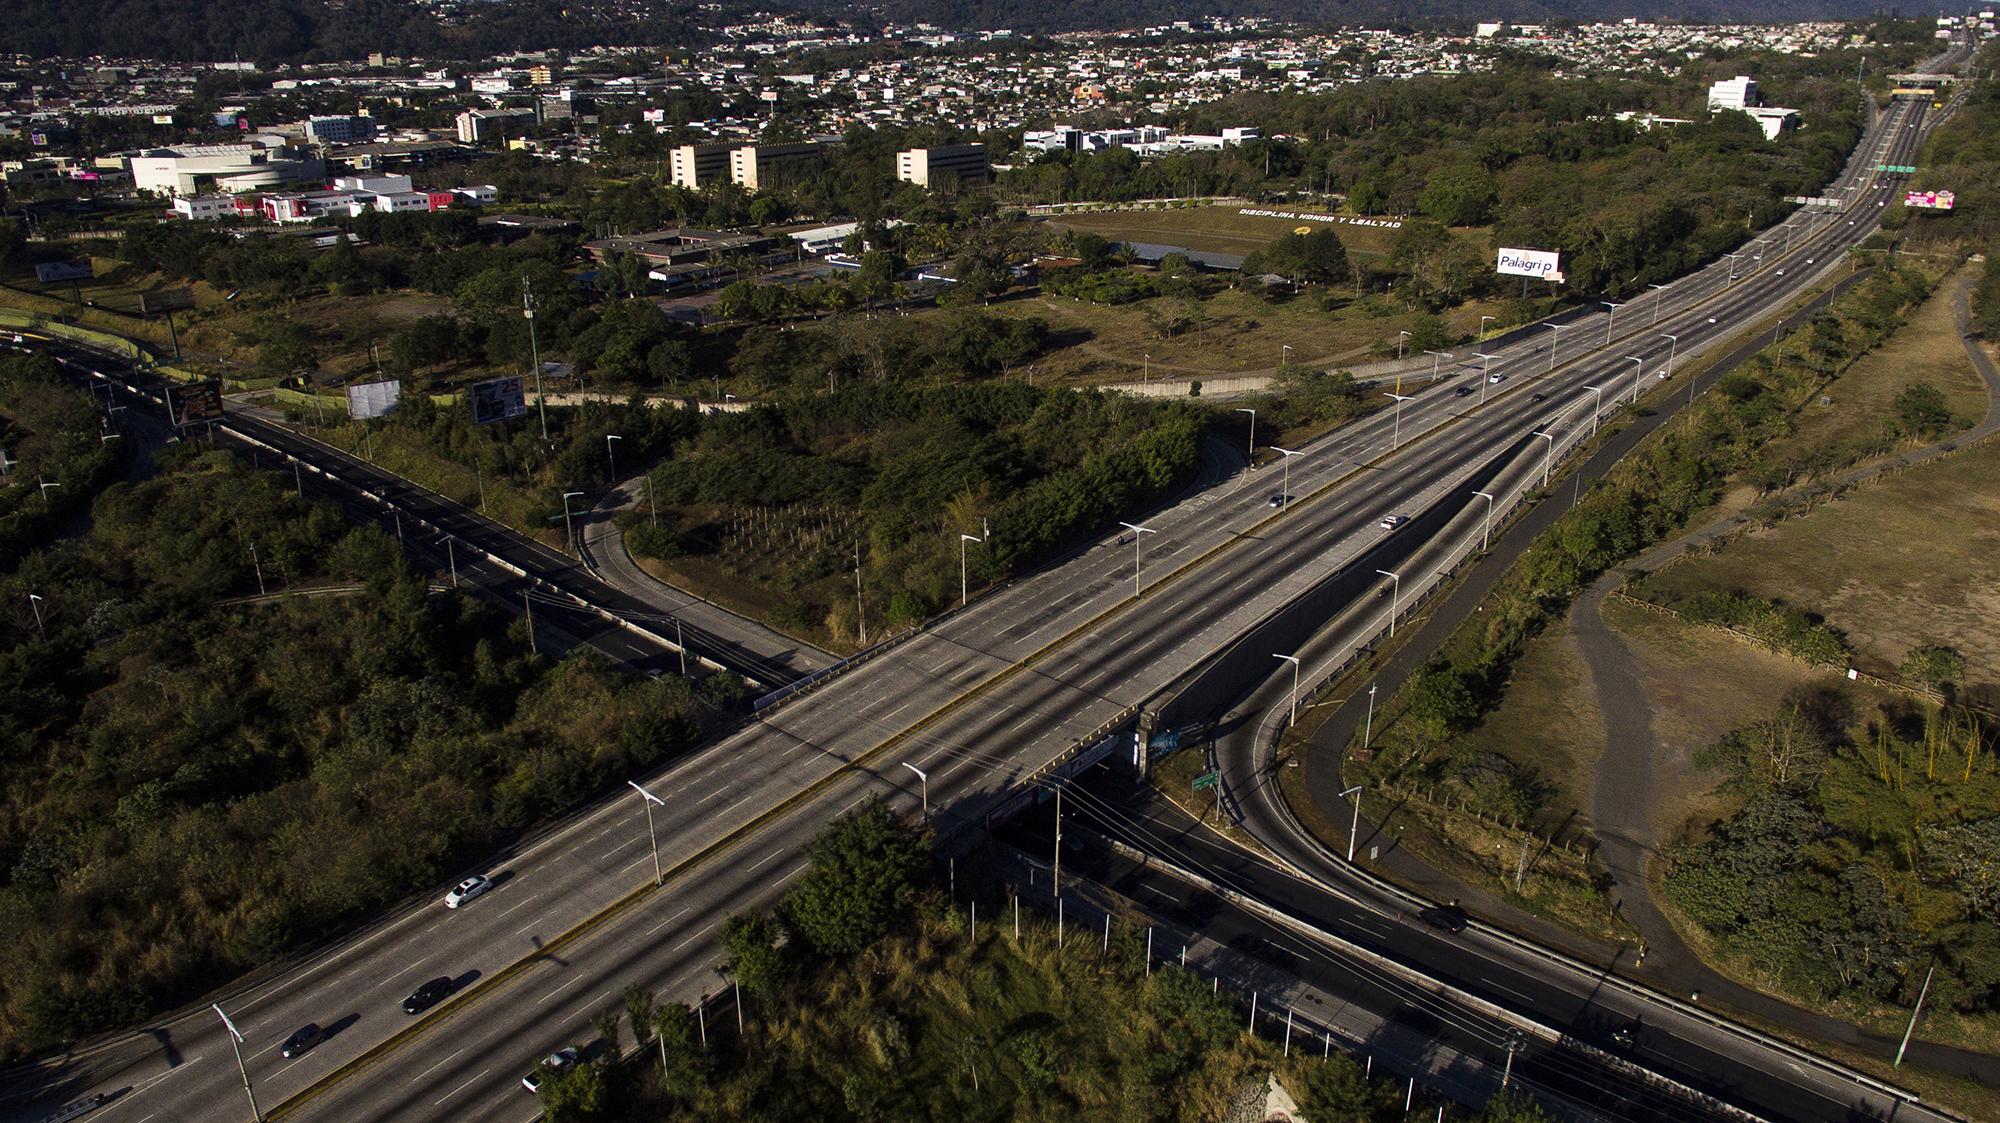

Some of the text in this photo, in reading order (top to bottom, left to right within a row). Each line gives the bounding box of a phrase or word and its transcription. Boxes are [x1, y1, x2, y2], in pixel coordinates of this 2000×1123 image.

[1239, 208, 1295, 219] DISCIPLINA
[1299, 213, 1335, 223] HONOR
[1349, 218, 1402, 228] LEALTAD
[502, 379, 519, 394] 25
